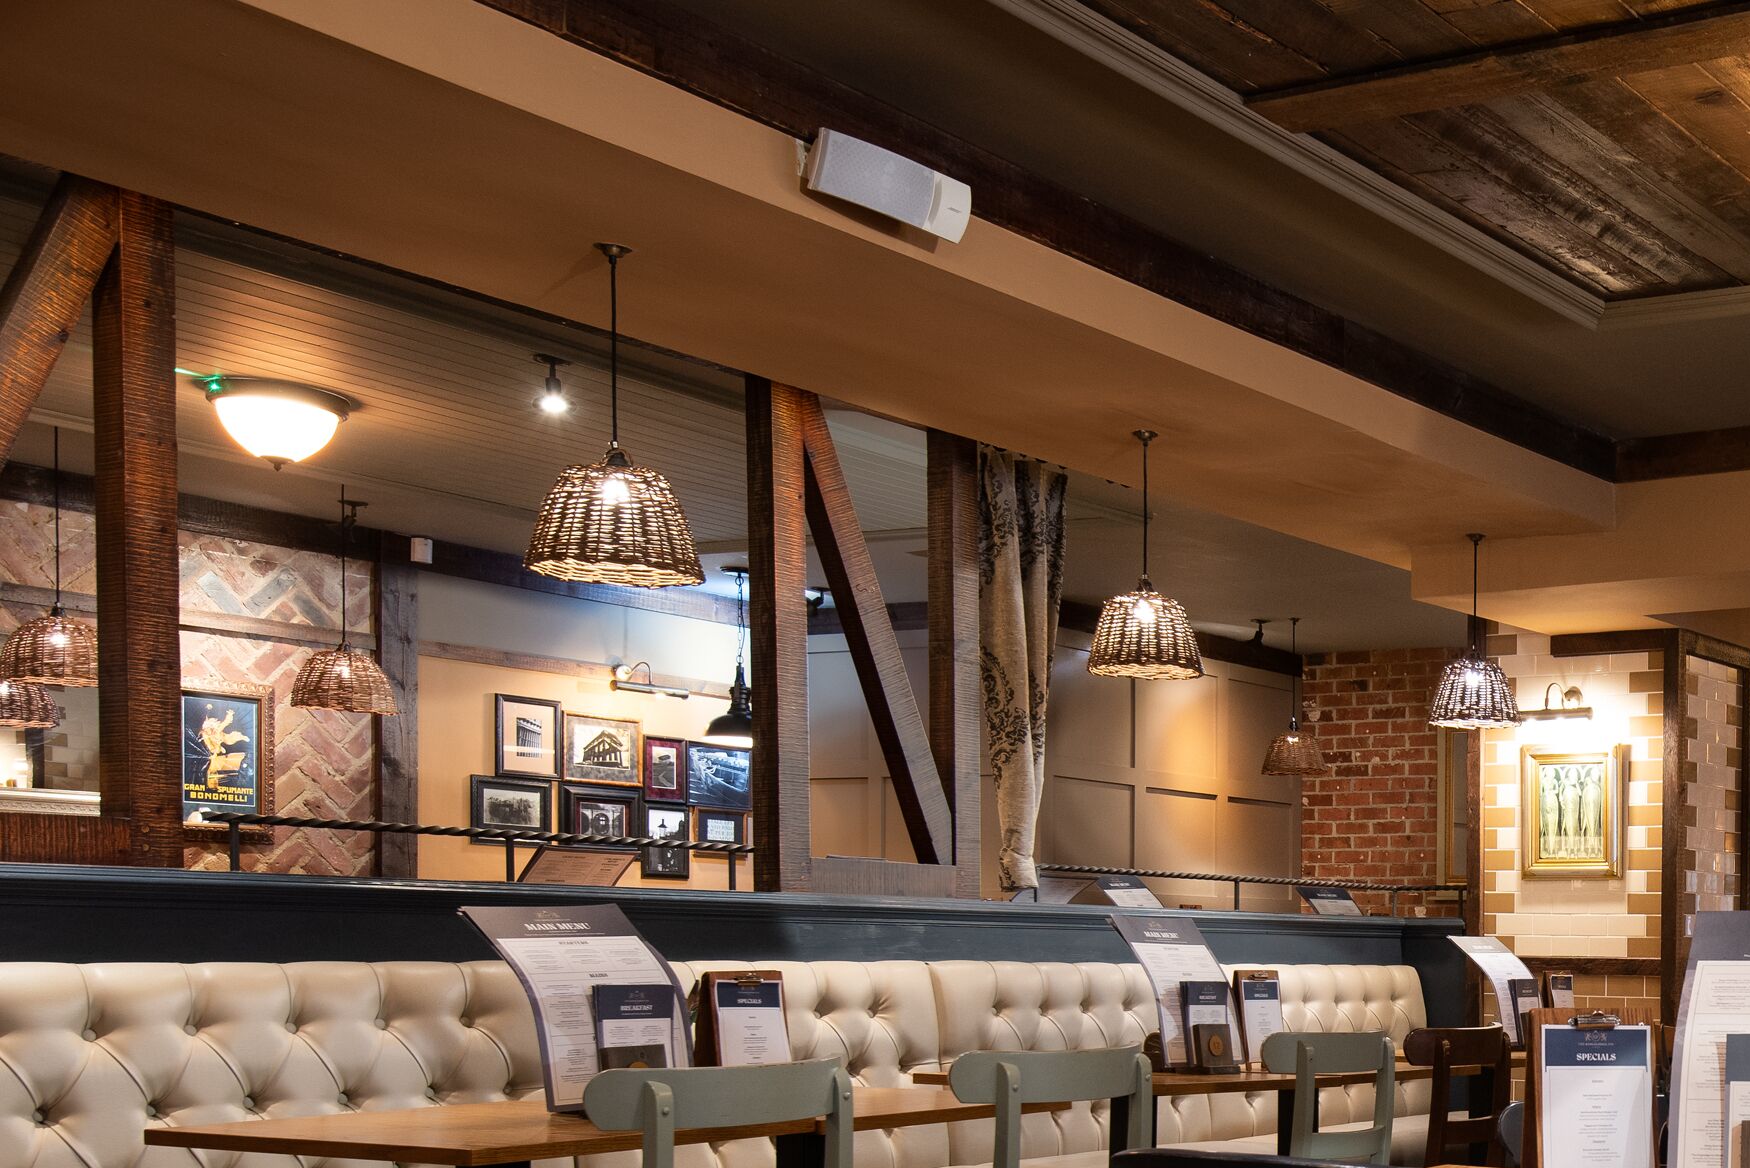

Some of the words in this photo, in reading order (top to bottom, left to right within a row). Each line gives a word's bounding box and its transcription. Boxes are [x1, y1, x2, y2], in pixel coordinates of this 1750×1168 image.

[184, 783, 205, 791] GRAN
[217, 786, 253, 795] SPUMANTE
[190, 791, 248, 802] BONOMELLI
[523, 922, 557, 931] MAIN
[556, 922, 592, 931] MENU
[1576, 1053, 1617, 1061] SPECIALS
